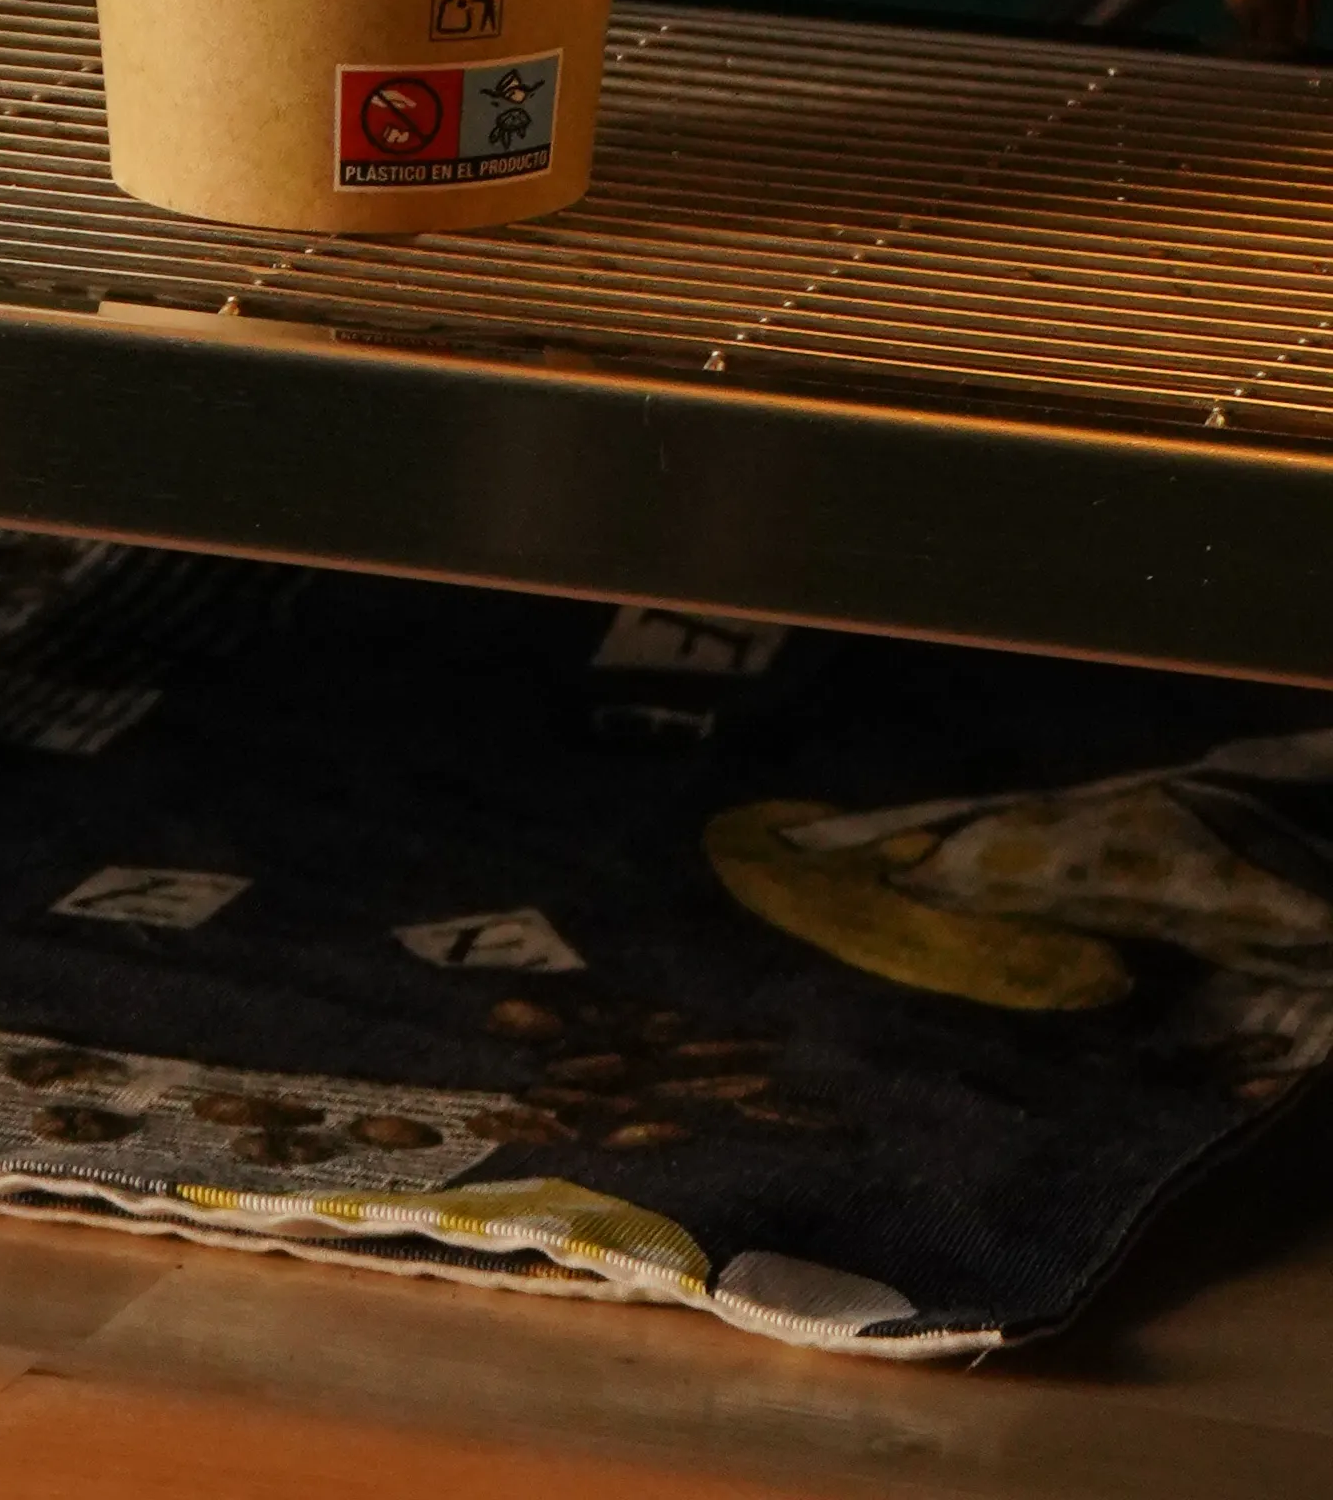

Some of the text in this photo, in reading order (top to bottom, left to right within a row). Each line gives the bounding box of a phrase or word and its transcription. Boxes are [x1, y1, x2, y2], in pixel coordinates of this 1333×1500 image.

[431, 163, 453, 181] EN
[457, 160, 475, 178] EL
[479, 149, 550, 177] PRODUCTO
